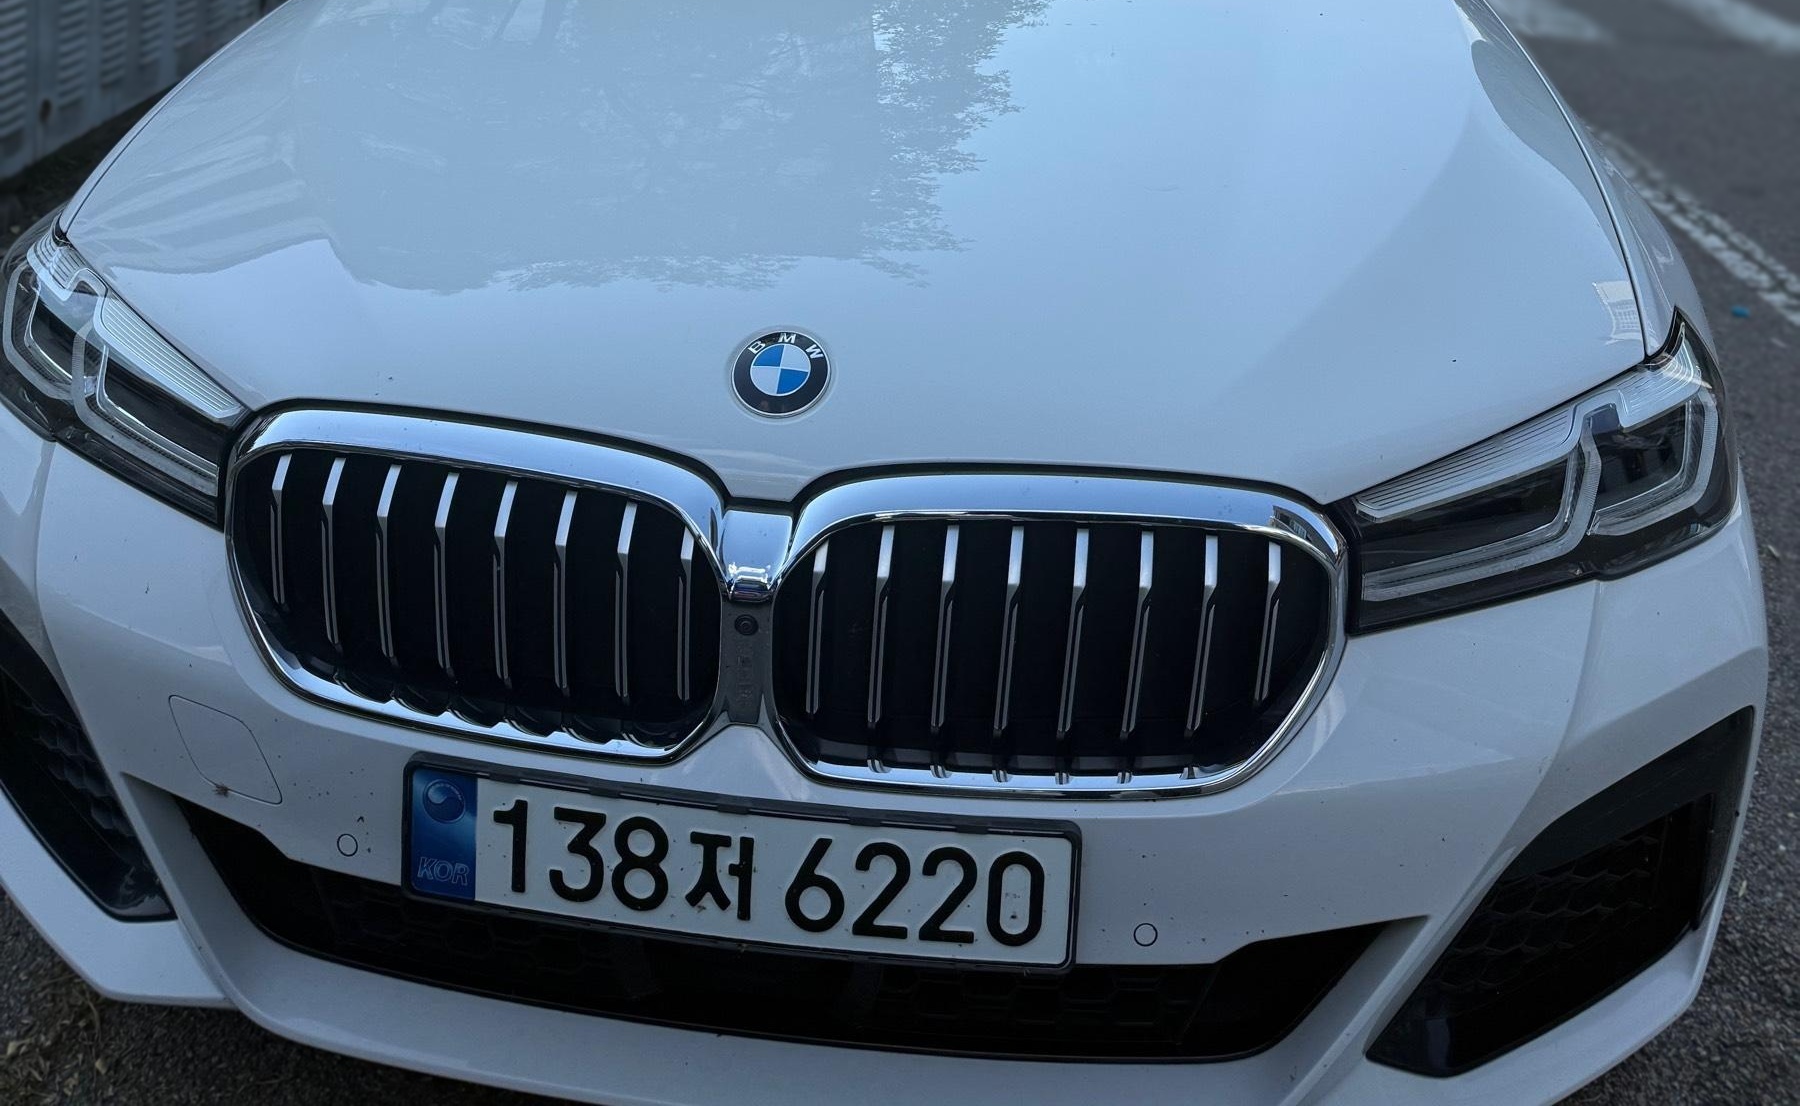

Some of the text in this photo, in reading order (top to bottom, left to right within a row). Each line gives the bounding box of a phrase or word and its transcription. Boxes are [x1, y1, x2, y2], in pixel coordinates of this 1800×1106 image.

[747, 332, 825, 359] BMW
[417, 856, 470, 886] KOR
[492, 798, 1046, 947] 138저 6220
